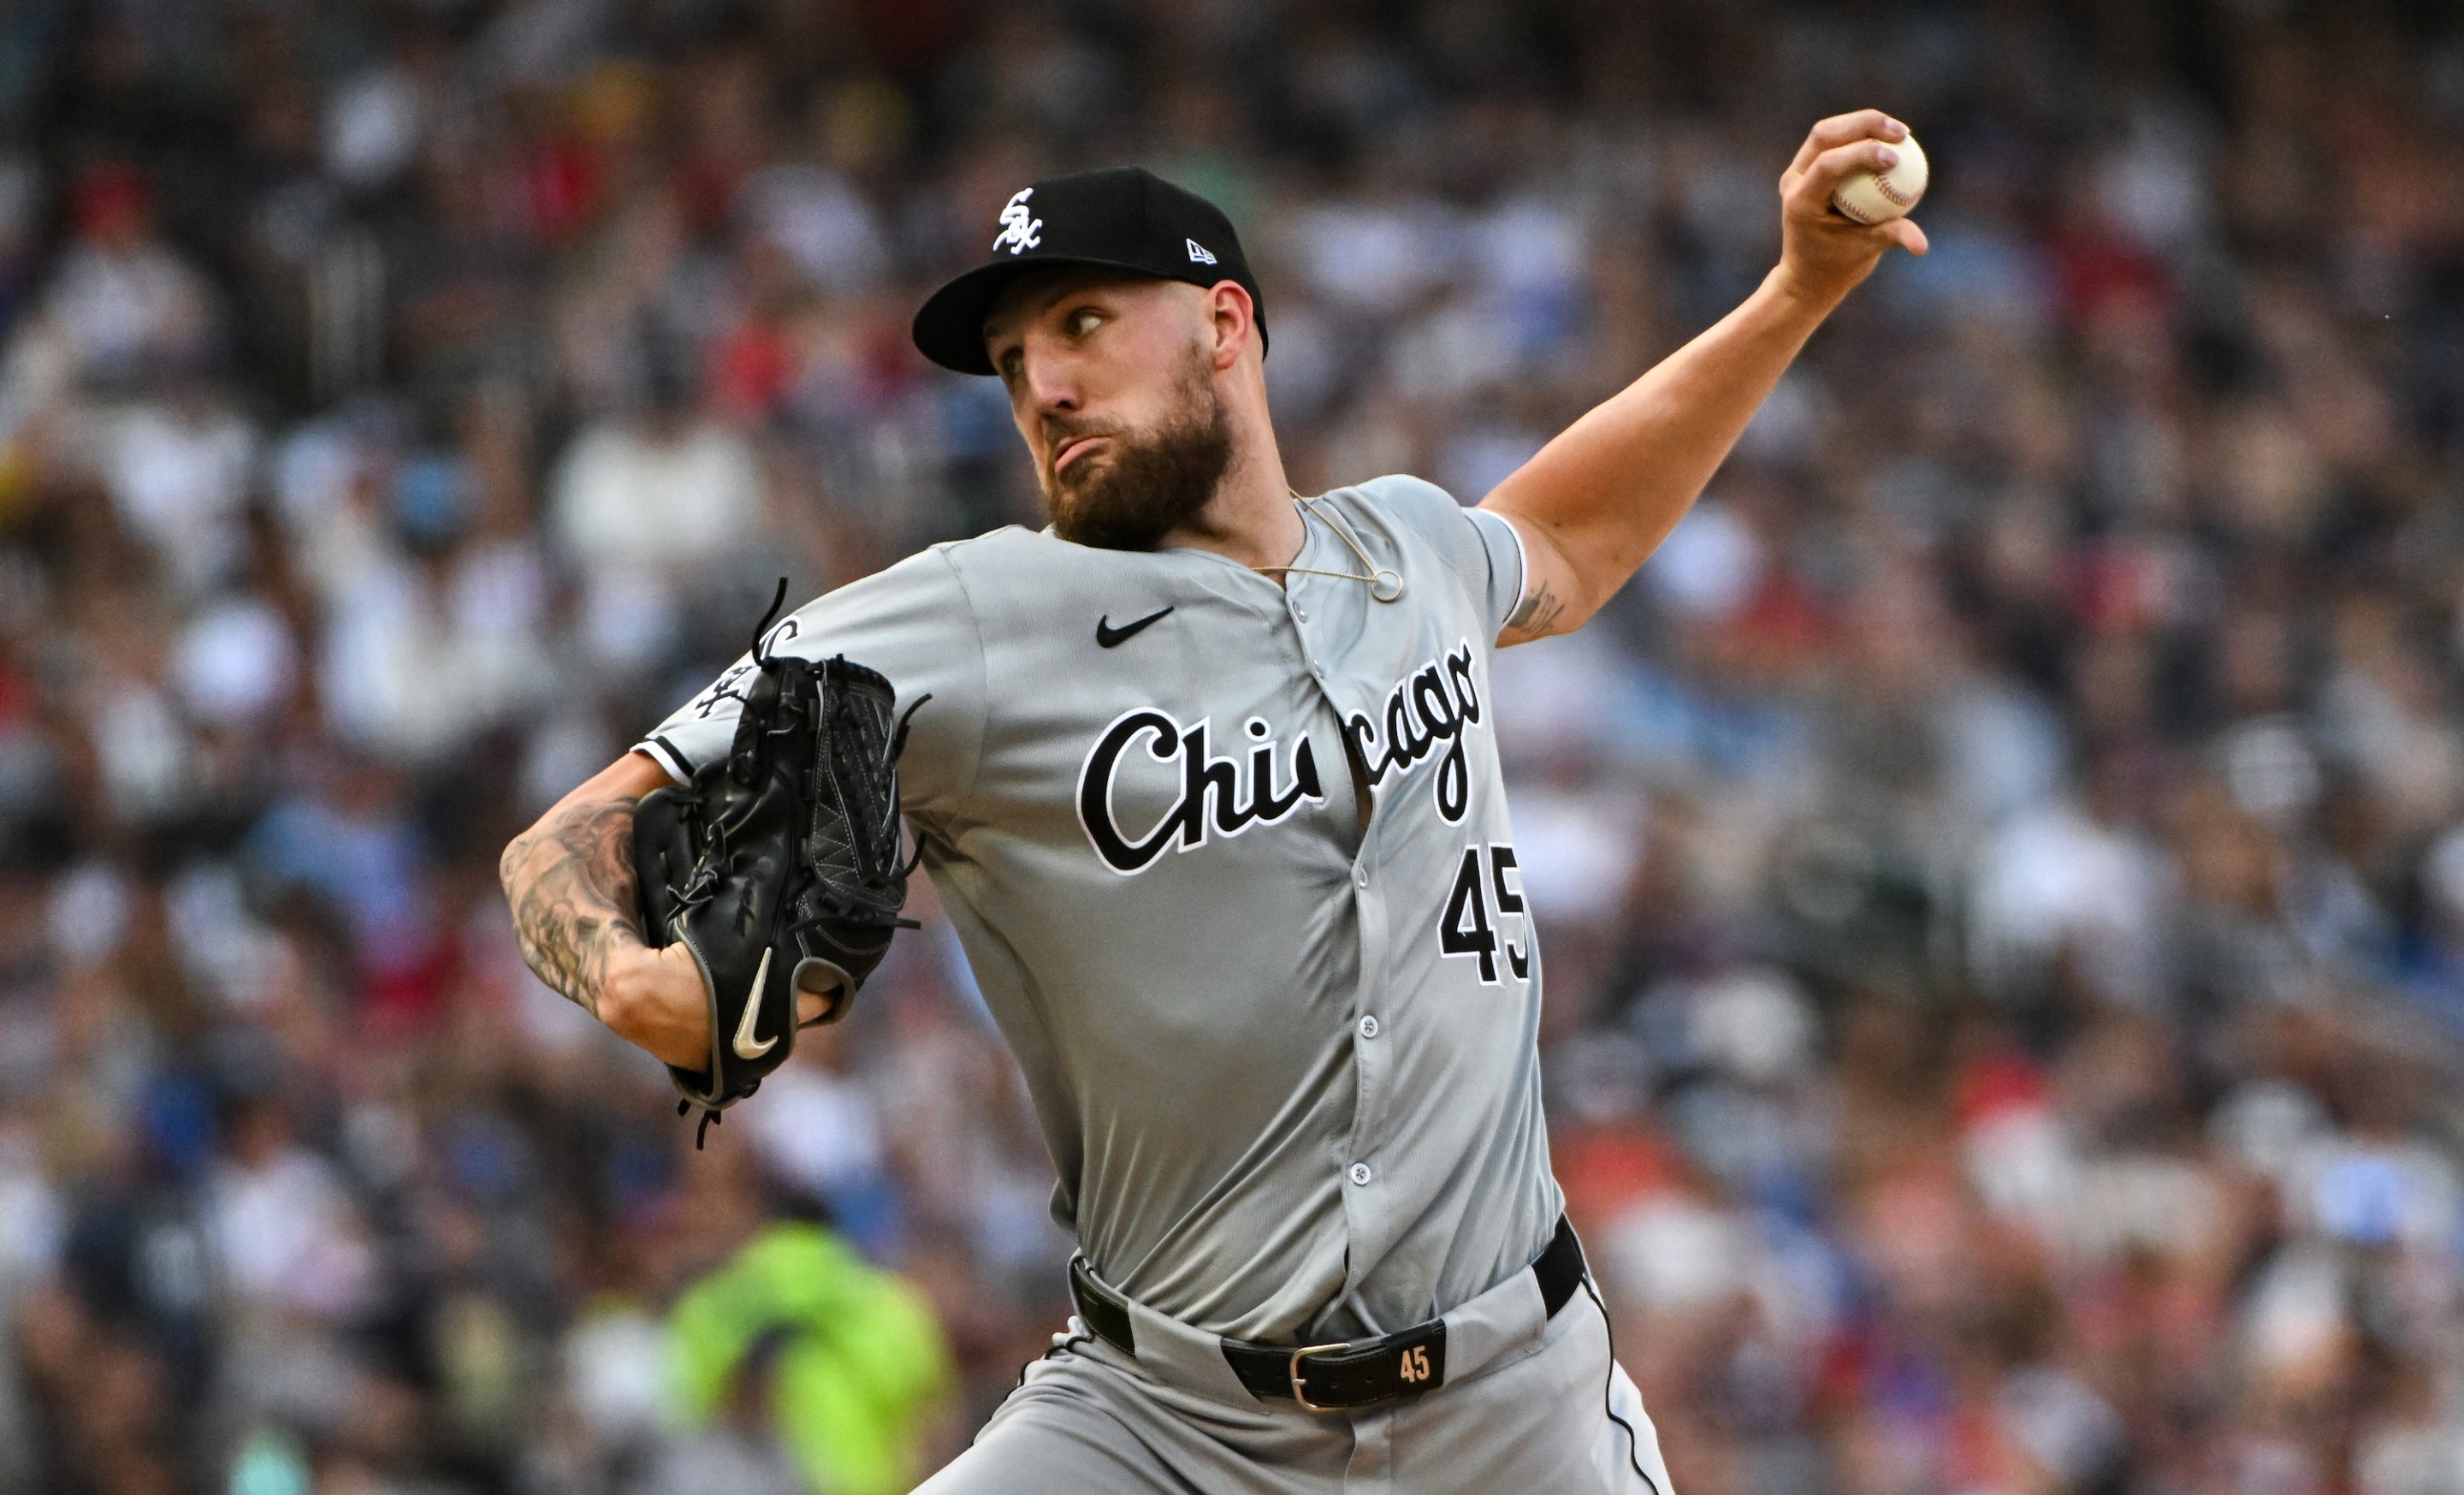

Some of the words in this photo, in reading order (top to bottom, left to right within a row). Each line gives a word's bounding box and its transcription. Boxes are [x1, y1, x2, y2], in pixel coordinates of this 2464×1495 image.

[1076, 637, 1481, 876] Chicago
[1436, 841, 1529, 987] 45
[1399, 1344, 1430, 1384] 45
